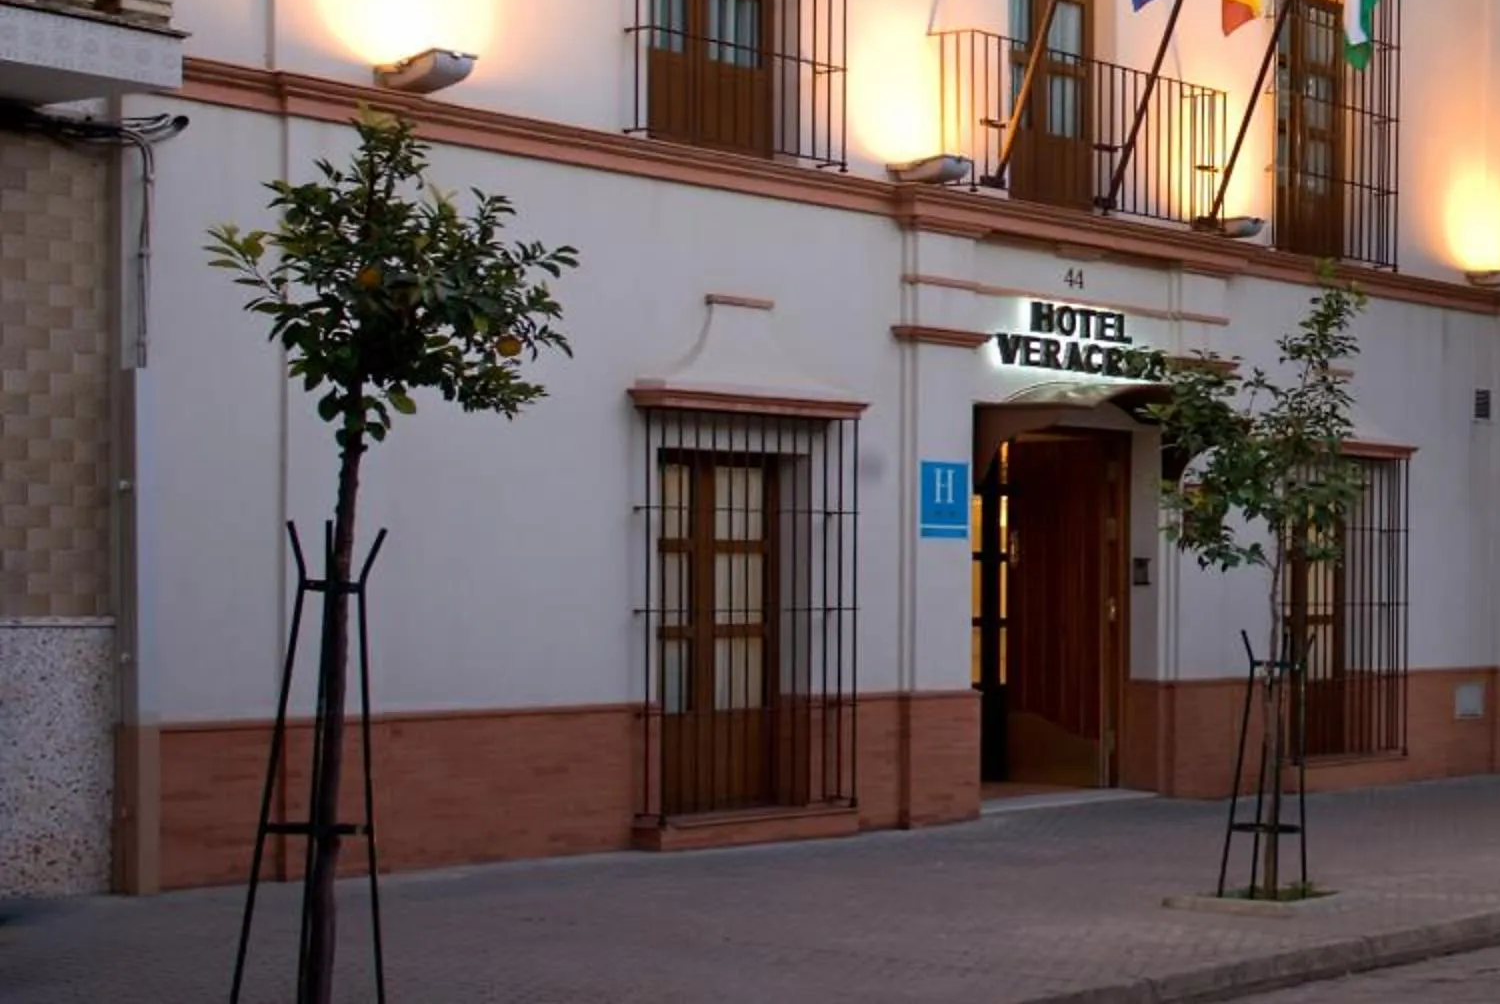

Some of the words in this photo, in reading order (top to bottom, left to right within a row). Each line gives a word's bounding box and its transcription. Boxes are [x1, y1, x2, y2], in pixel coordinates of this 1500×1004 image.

[1063, 268, 1085, 289] 44
[1030, 301, 1133, 344] HOTEL
[997, 333, 1164, 381] VERACRZ
[934, 467, 955, 504] H
